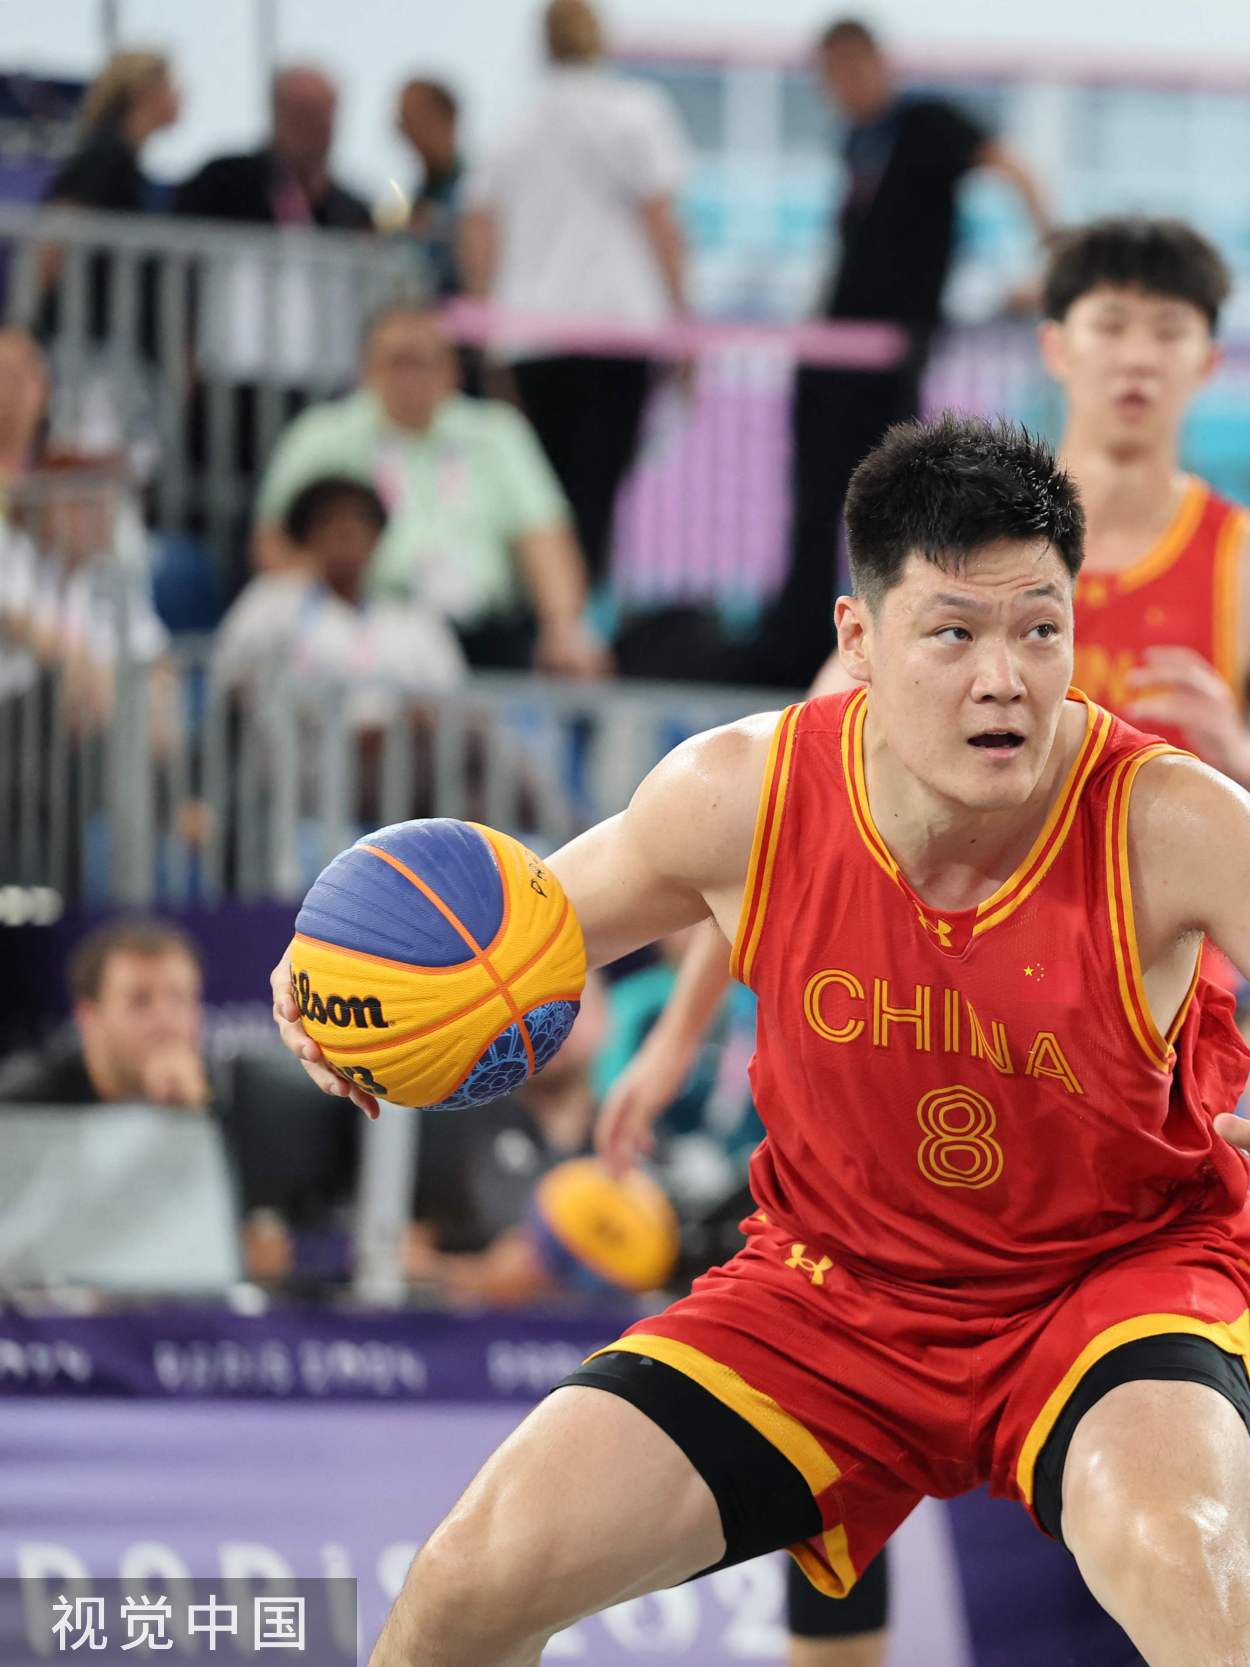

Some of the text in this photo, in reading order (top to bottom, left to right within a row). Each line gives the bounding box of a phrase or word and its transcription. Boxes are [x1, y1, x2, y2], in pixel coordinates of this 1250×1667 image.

[289, 968, 390, 1029] ilson
[803, 967, 1084, 1094] CHINA
[916, 1084, 1004, 1190] 8
